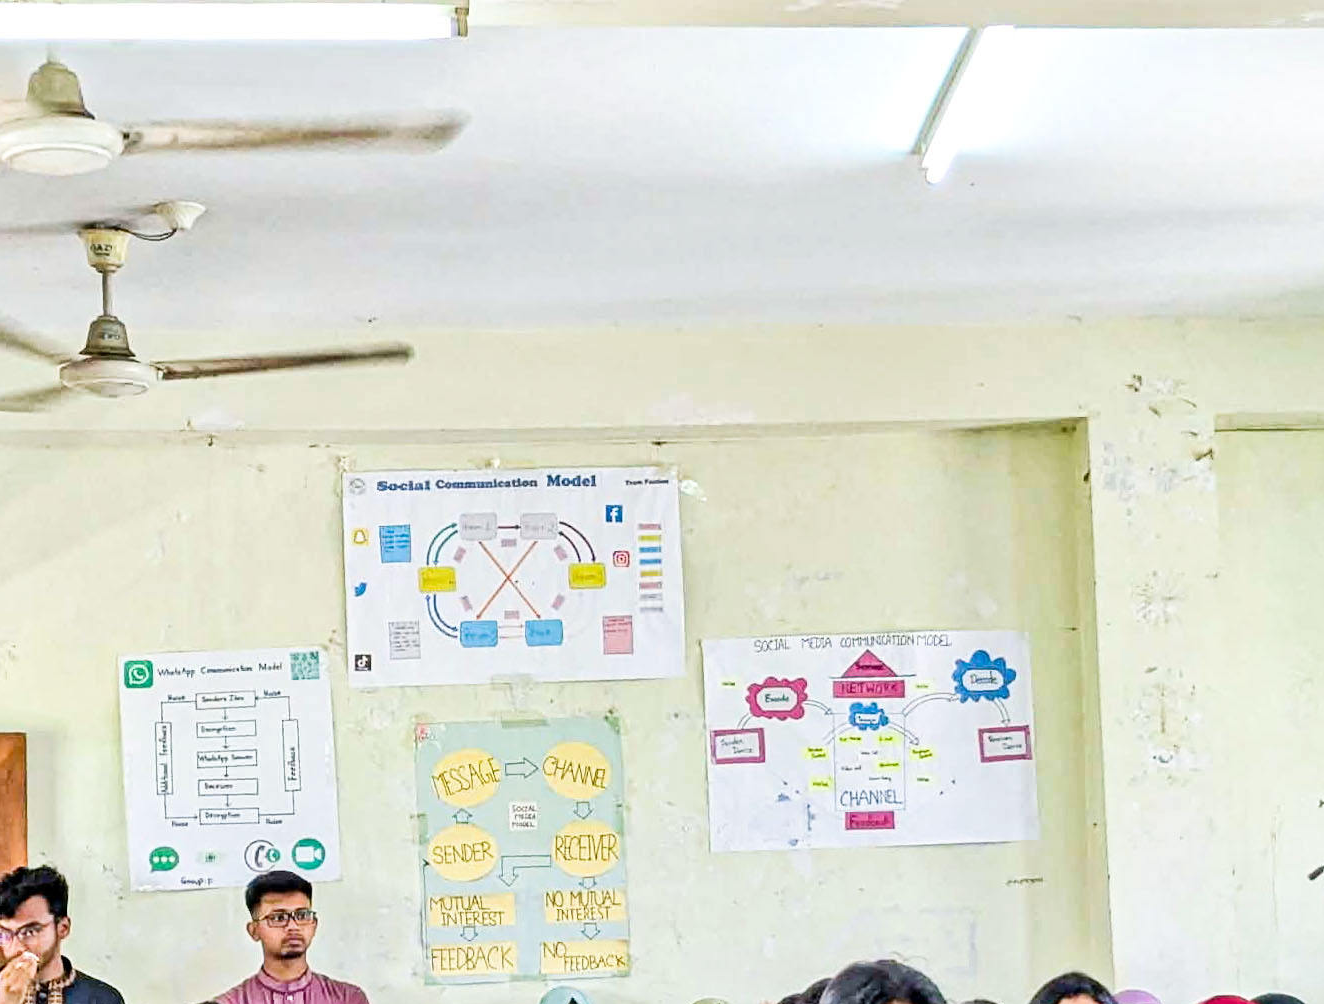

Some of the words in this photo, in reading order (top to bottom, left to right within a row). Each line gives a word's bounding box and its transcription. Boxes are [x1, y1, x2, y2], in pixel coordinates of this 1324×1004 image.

[377, 480, 431, 491] Social
[435, 478, 538, 490] Communication
[546, 474, 597, 487] Model
[754, 639, 790, 653] SOCIAL
[801, 636, 832, 649] MEDIA
[916, 633, 953, 647] MODEL
[258, 662, 283, 672] Model
[431, 756, 501, 799] MESSAGE
[542, 755, 607, 789] CHANNEL
[839, 788, 903, 807] CHANNEL
[432, 840, 494, 866] SENDER
[554, 833, 619, 863] RECEIVER
[429, 894, 491, 912] MUTUAL
[546, 891, 565, 908] NO
[569, 890, 622, 908] MUTUAL
[441, 911, 505, 927] INTEREST
[556, 906, 612, 922] INTEREST
[431, 945, 515, 971] FEEDBACK
[542, 942, 567, 959] NO
[563, 953, 626, 972] FEEDBACK
